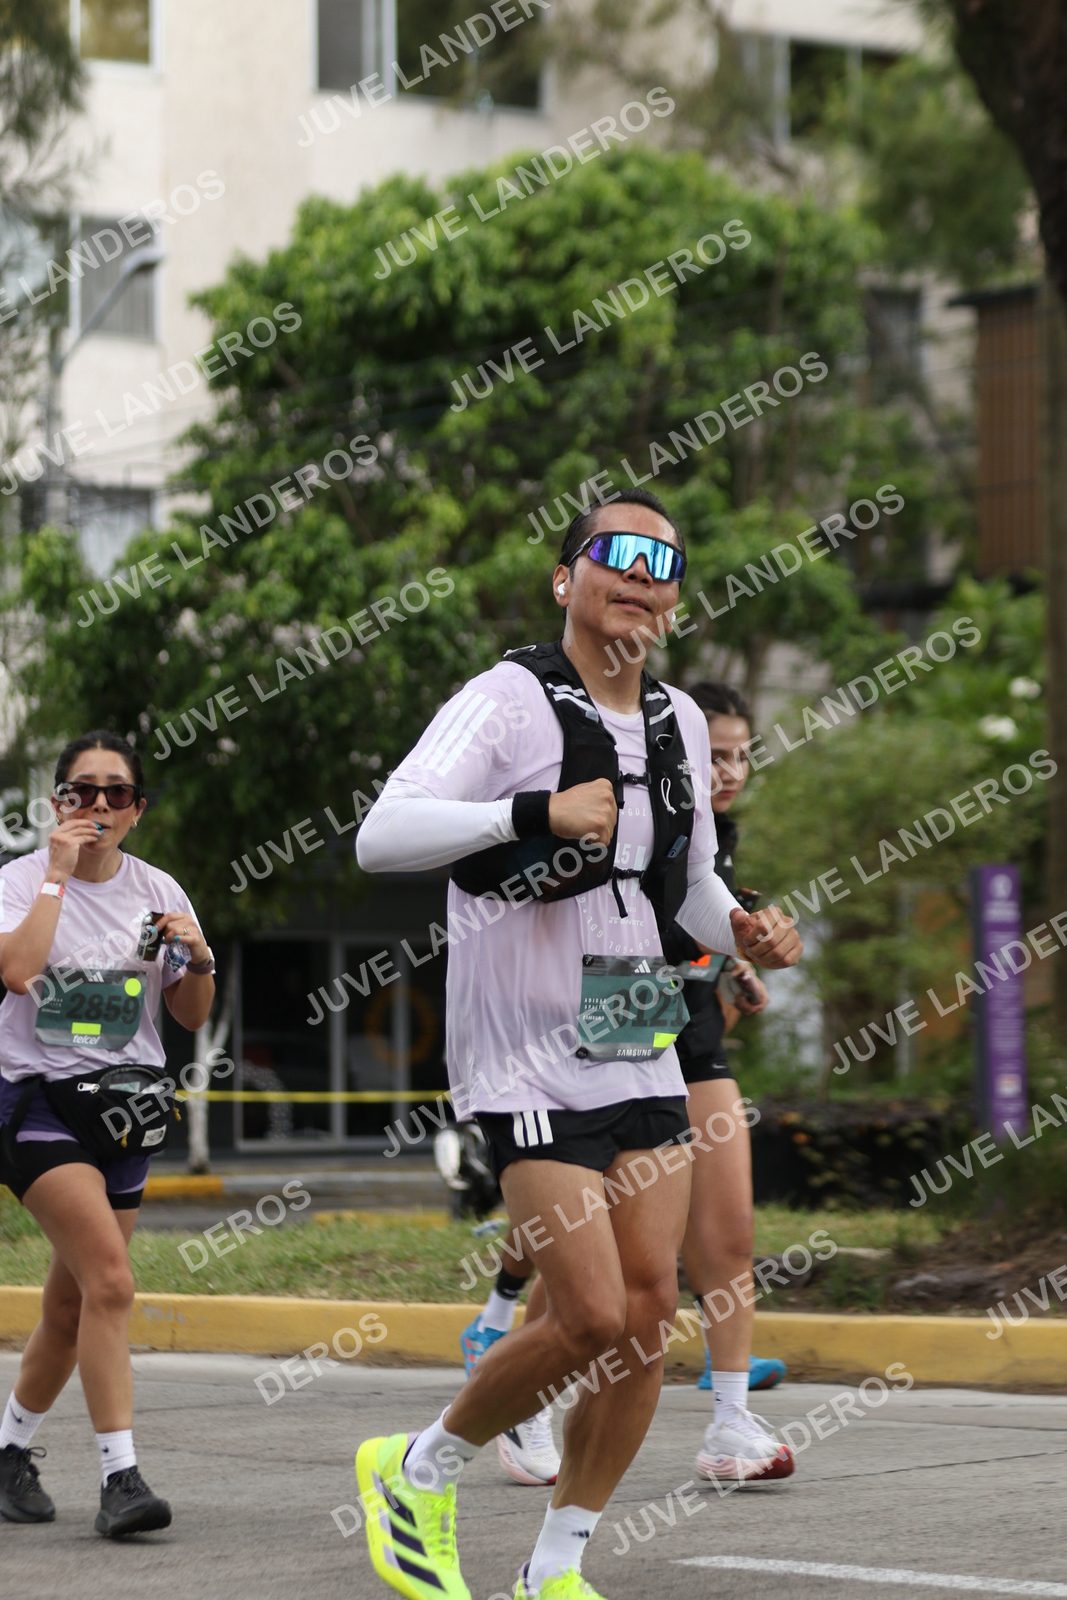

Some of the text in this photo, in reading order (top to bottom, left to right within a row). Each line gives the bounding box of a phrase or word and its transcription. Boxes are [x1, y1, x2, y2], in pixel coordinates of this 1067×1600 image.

[65, 992, 140, 1024] 2859
[72, 1035, 101, 1044] telcel
[616, 1049, 652, 1057] SAMSUNG
